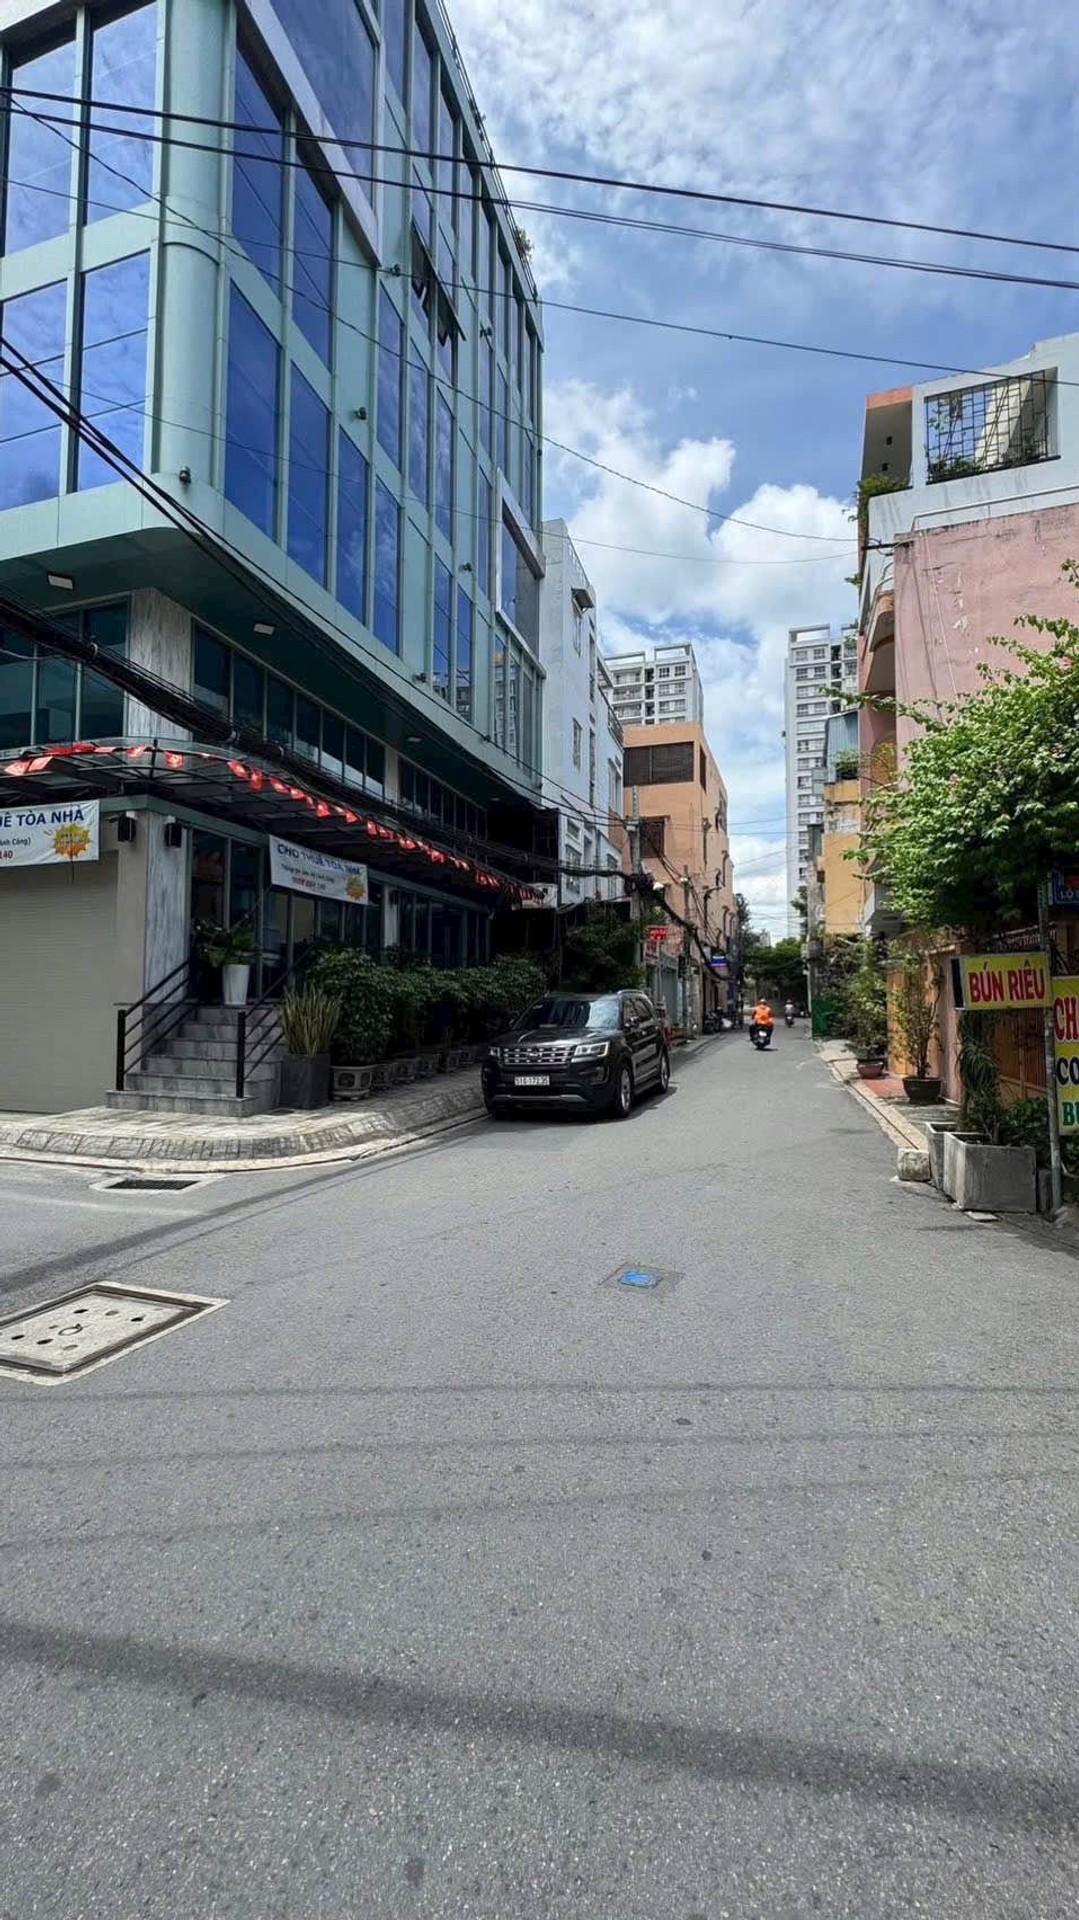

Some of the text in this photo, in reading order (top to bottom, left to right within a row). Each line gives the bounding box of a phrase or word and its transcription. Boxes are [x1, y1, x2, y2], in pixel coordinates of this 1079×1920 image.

[16, 810, 46, 827] TÒA
[51, 806, 84, 823] NHÀ
[278, 844, 299, 858] CHO
[969, 959, 1045, 1002] BÚN RIÊU
